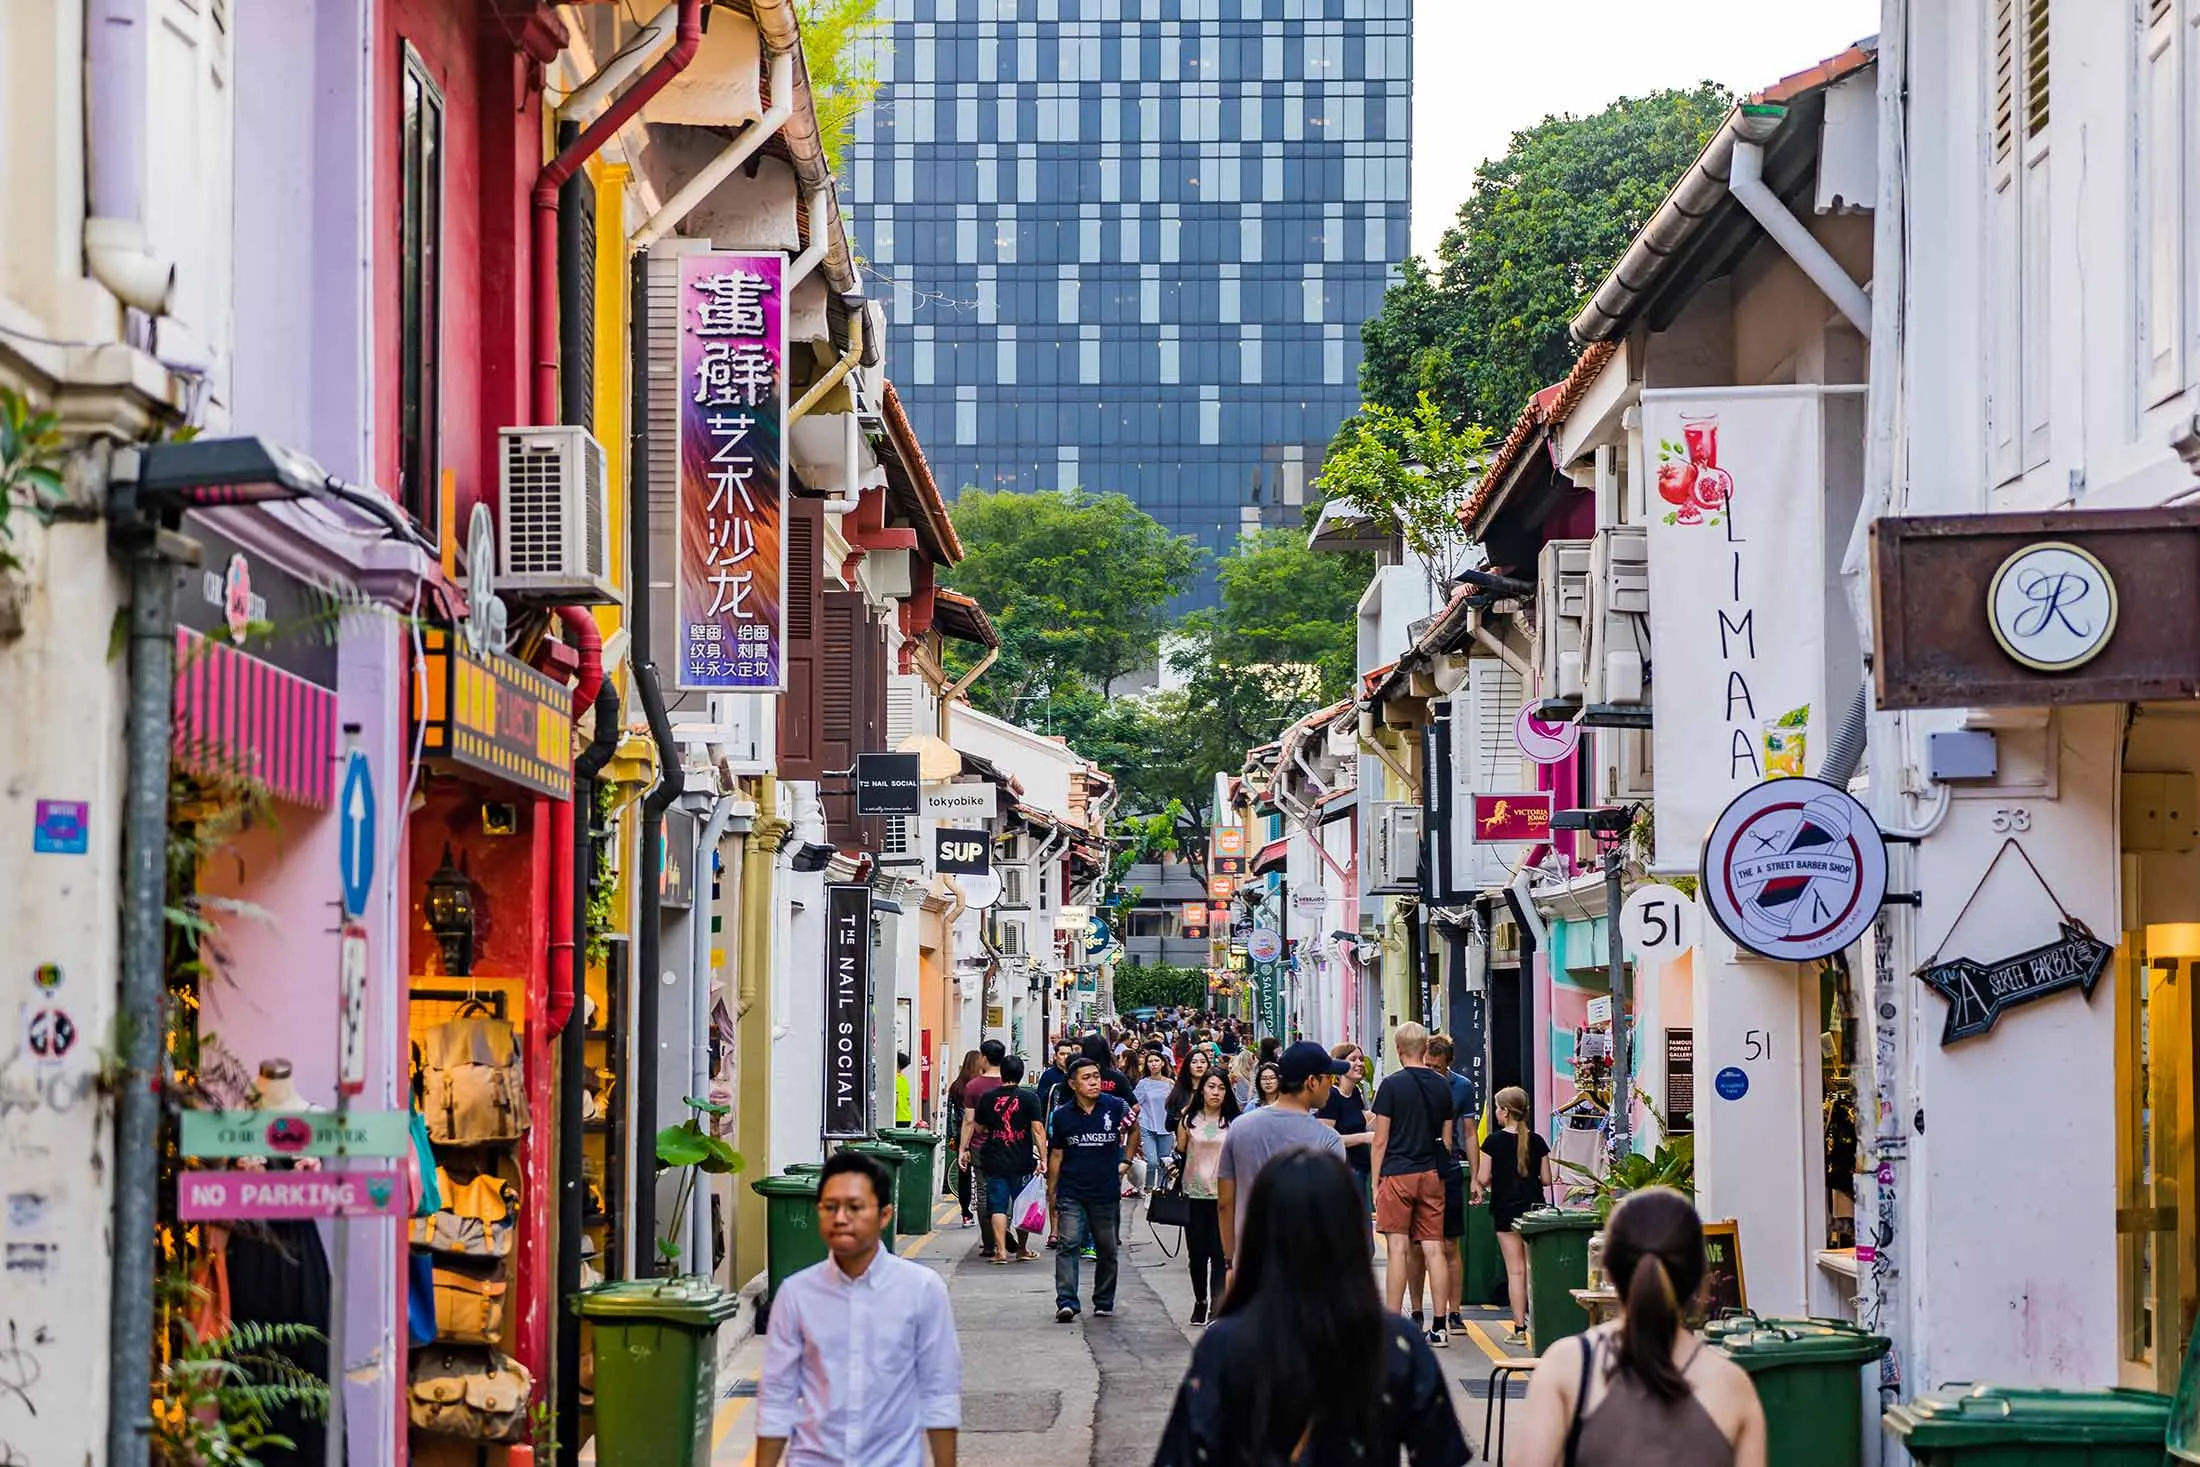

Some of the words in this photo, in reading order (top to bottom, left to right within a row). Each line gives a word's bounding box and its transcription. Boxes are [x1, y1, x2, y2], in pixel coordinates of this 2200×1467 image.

[929, 796, 984, 808] tokyobike
[1513, 808, 1548, 816] VICTORIA
[1991, 808, 2031, 832] 53
[939, 841, 983, 862] SUP
[1737, 868, 1753, 880] THE
[1756, 864, 1763, 874] A
[1766, 860, 1795, 872] STREET
[1796, 860, 1828, 871] BARBER
[1829, 861, 1851, 874] SHOP
[840, 914, 856, 945] THE
[1638, 901, 1680, 947] 51
[839, 957, 854, 1009] NAIL
[1960, 969, 1990, 1024] A
[2029, 944, 2083, 985] BARBER
[1744, 1030, 1771, 1061] 51
[837, 1022, 853, 1107] SOCIAL
[1080, 1132, 1117, 1143] ANGELES
[191, 1183, 227, 1208] NO
[239, 1183, 355, 1207] PARKING
